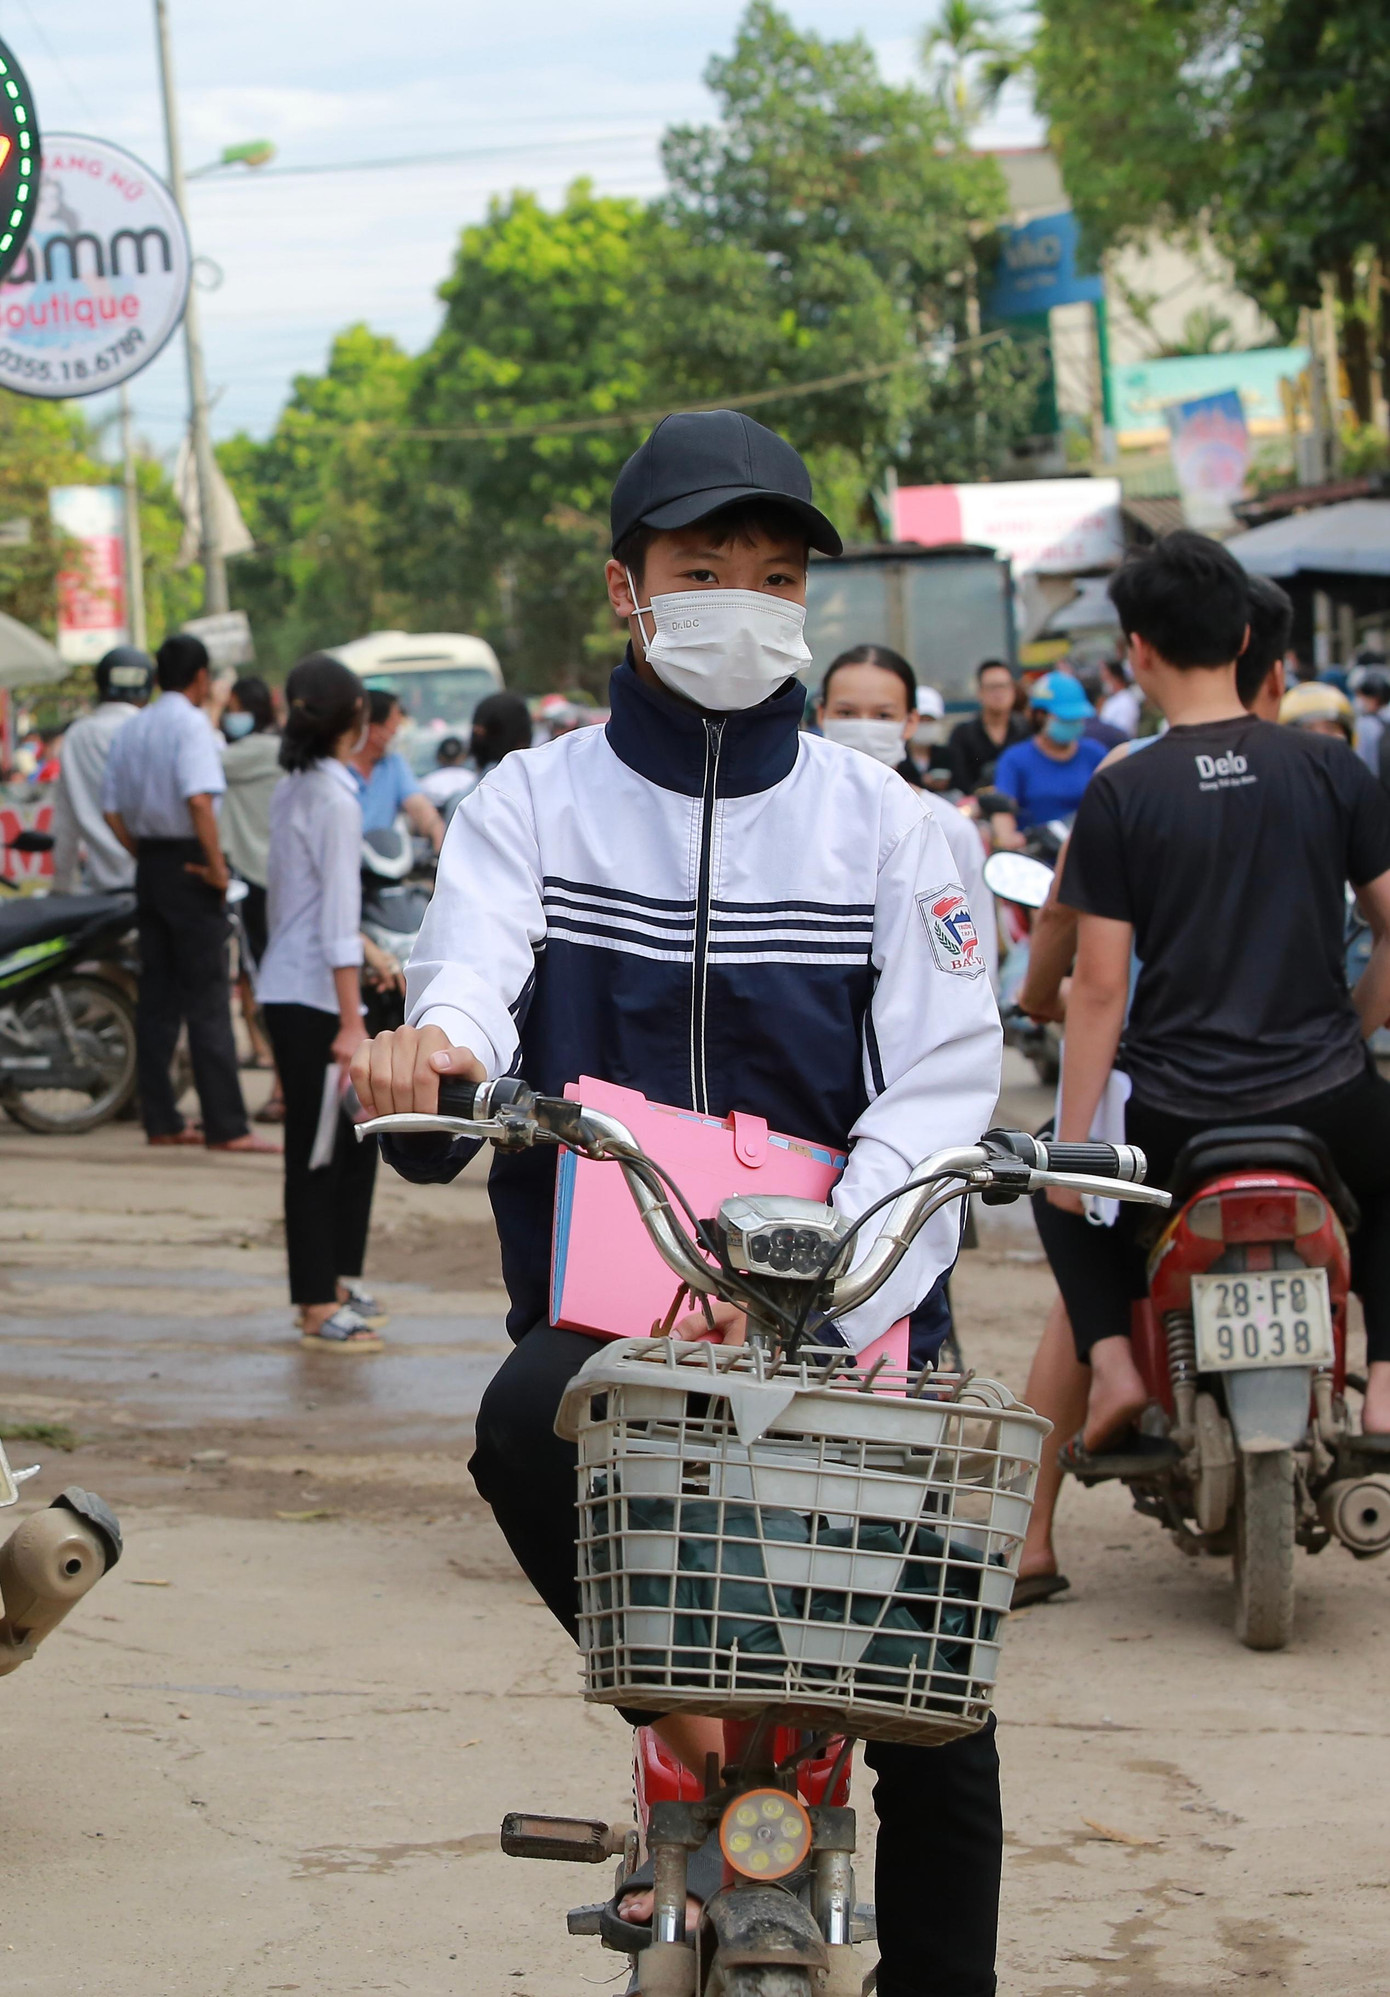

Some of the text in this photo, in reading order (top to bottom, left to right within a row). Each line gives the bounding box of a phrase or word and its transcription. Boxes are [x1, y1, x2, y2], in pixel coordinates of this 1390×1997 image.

[41, 155, 103, 177] ANG
[0, 294, 140, 329] outique
[1195, 749, 1248, 779] Delo
[1218, 1321, 1311, 1360] 9038
